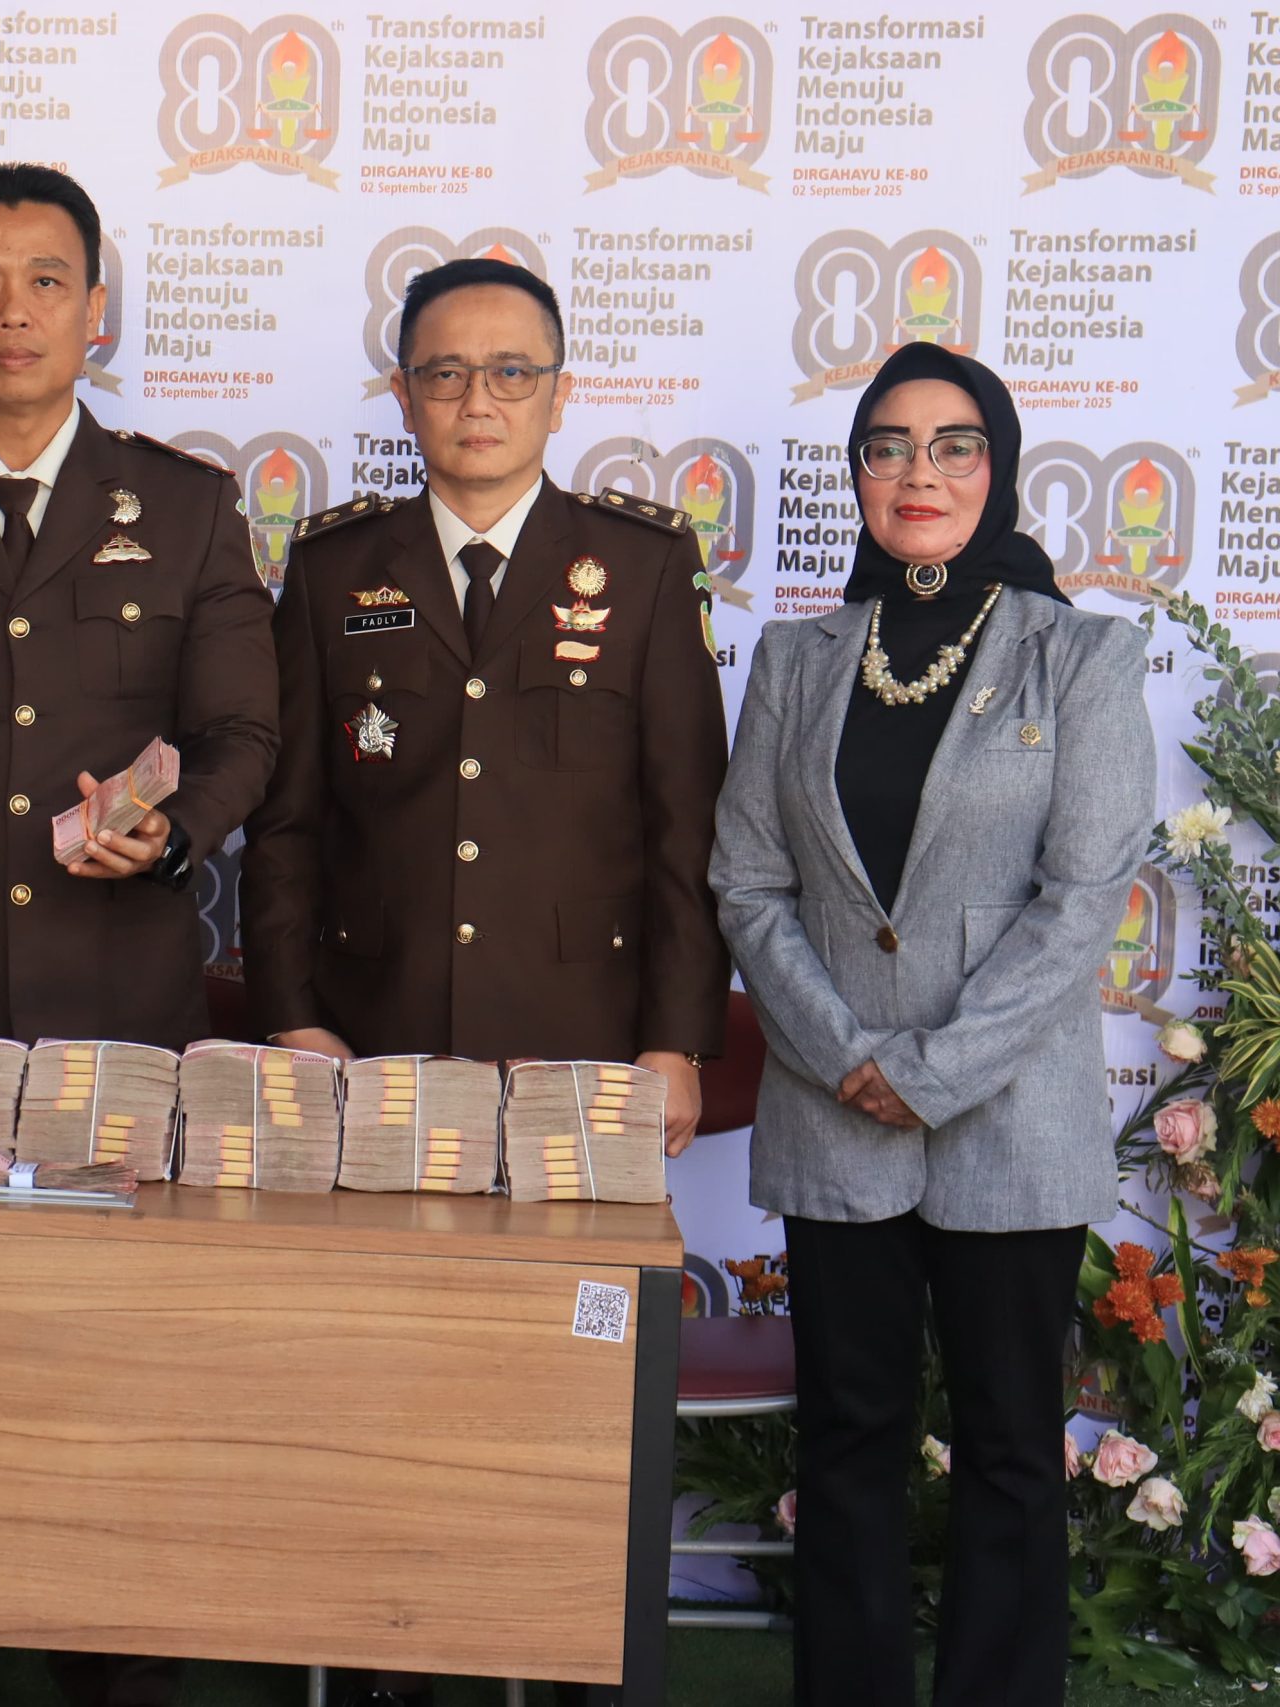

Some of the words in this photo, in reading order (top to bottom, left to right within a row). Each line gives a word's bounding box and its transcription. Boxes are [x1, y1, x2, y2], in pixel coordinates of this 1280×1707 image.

[331, 19, 344, 31] th
[367, 14, 544, 39] Transformasi
[764, 21, 778, 33] th
[801, 15, 984, 39] Transformasi
[1212, 17, 1226, 29] th
[364, 44, 504, 72] Kejaksaan
[798, 45, 941, 73] Kejaksaan
[364, 74, 467, 103] Menuju
[797, 75, 903, 105] Menuju
[364, 100, 496, 124] Indonesia
[796, 102, 932, 126] Indonesia
[363, 128, 430, 157] Maju
[795, 130, 864, 159] Maju
[189, 147, 278, 169] KEJAKSAAN
[281, 153, 304, 171] R.I.
[618, 150, 708, 172] KEJAKSAAN
[711, 155, 735, 174] R.I.
[1057, 150, 1152, 173] KEJAKSAAN
[1155, 155, 1178, 173] R.I.
[361, 166, 446, 178] DIRGAHAYU
[452, 167, 492, 178] KE-80
[793, 168, 880, 180] DIRGAHAYU
[886, 169, 928, 180] KE-80
[361, 182, 373, 193] 02
[378, 182, 437, 196] September
[441, 182, 467, 194] 2025
[792, 185, 805, 196] 02
[810, 185, 870, 199] September
[874, 185, 902, 196] 2025
[1239, 184, 1253, 195] 02
[113, 227, 126, 238] th
[148, 223, 323, 247] Transformasi
[538, 232, 551, 244] th
[573, 227, 752, 251] Transformasi
[973, 234, 987, 246] th
[1010, 229, 1196, 252] Transformasi
[147, 252, 283, 281] Kejaksaan
[572, 256, 711, 286] Kejaksaan
[1008, 258, 1152, 288] Kejaksaan
[146, 281, 248, 310] Menuju
[571, 286, 674, 315] Menuju
[1006, 288, 1113, 318] Menuju
[145, 307, 276, 331] Indonesia
[570, 312, 703, 336] Indonesia
[1005, 315, 1143, 338] Indonesia
[145, 334, 211, 363] Maju
[569, 340, 636, 368] Maju
[1003, 343, 1073, 372] Maju
[144, 371, 227, 383] DIRGAHAYU
[233, 372, 273, 384] KE-80
[658, 378, 699, 390] KE-80
[1096, 381, 1138, 393] KE-80
[144, 387, 156, 398] 02
[161, 387, 218, 400] September
[222, 388, 248, 399] 2025
[567, 393, 580, 404] 02
[584, 393, 643, 407] September
[646, 394, 674, 405] 2025
[1019, 397, 1080, 410] September
[1084, 397, 1111, 408] 2025
[319, 437, 332, 448] th
[746, 443, 759, 454] th
[1187, 447, 1200, 458] th
[777, 550, 844, 578] Maju
[775, 602, 788, 613] 02
[1215, 608, 1228, 619] 02
[363, 616, 396, 626] FADLY
